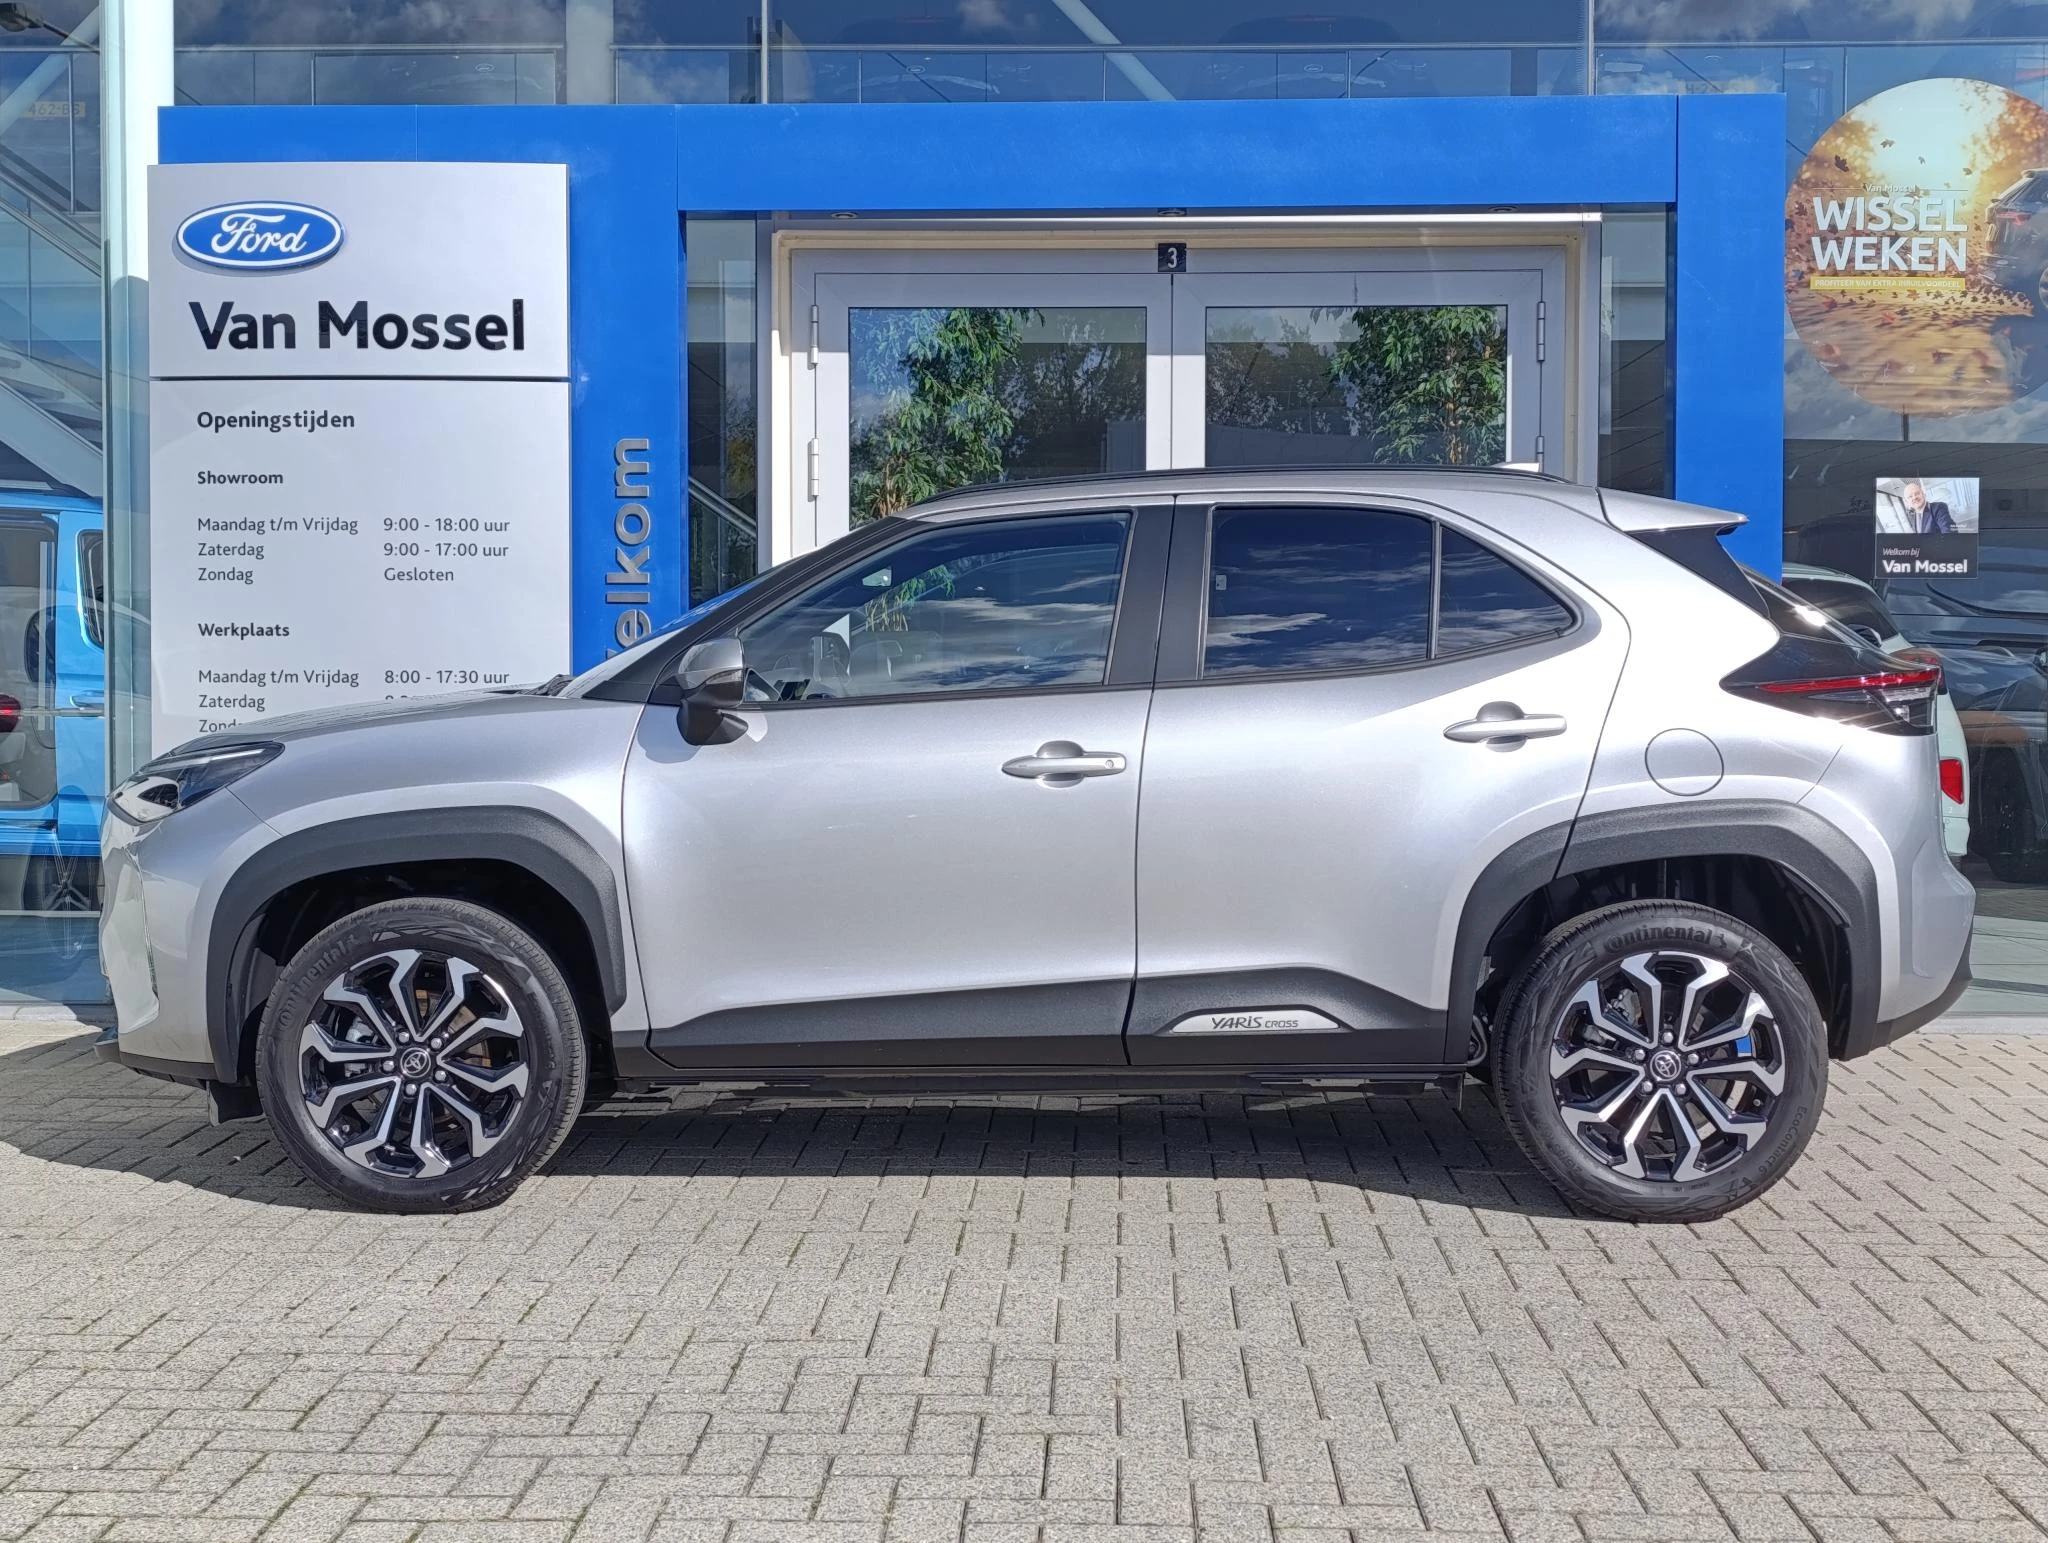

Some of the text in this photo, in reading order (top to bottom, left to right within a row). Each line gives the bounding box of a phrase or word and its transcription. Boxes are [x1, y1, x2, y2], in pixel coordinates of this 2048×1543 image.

[1812, 196, 1968, 232] WISSEL
[211, 213, 310, 254] Ford
[1167, 247, 1178, 268] 3
[1811, 236, 1967, 272] WEKEN
[188, 298, 525, 351] Van Mossel
[197, 409, 355, 434] Openingstijden
[197, 470, 284, 485] Showroom
[198, 517, 265, 536] Maandag
[269, 517, 298, 532] t/m
[302, 516, 359, 536] Vrijdag
[383, 517, 420, 532] 9:00
[435, 517, 480, 532] 18:00
[483, 521, 511, 533] uur
[198, 541, 265, 561] Zaterdag
[383, 542, 420, 557] 9:00
[435, 542, 478, 557] 17:00
[482, 546, 510, 557] uur
[198, 566, 454, 586] Zondag Gesloten
[1883, 559, 1968, 573] Van Mossel
[198, 621, 290, 641] Werkplaats
[198, 668, 266, 688] Maandag
[270, 668, 299, 684] t/m
[303, 668, 360, 688] Vrijdag
[384, 669, 421, 685] 8:00
[436, 669, 479, 684] 17:30
[483, 673, 510, 684] uur
[199, 693, 266, 713] Zaterdag
[1264, 1020, 1299, 1029] CROSS
